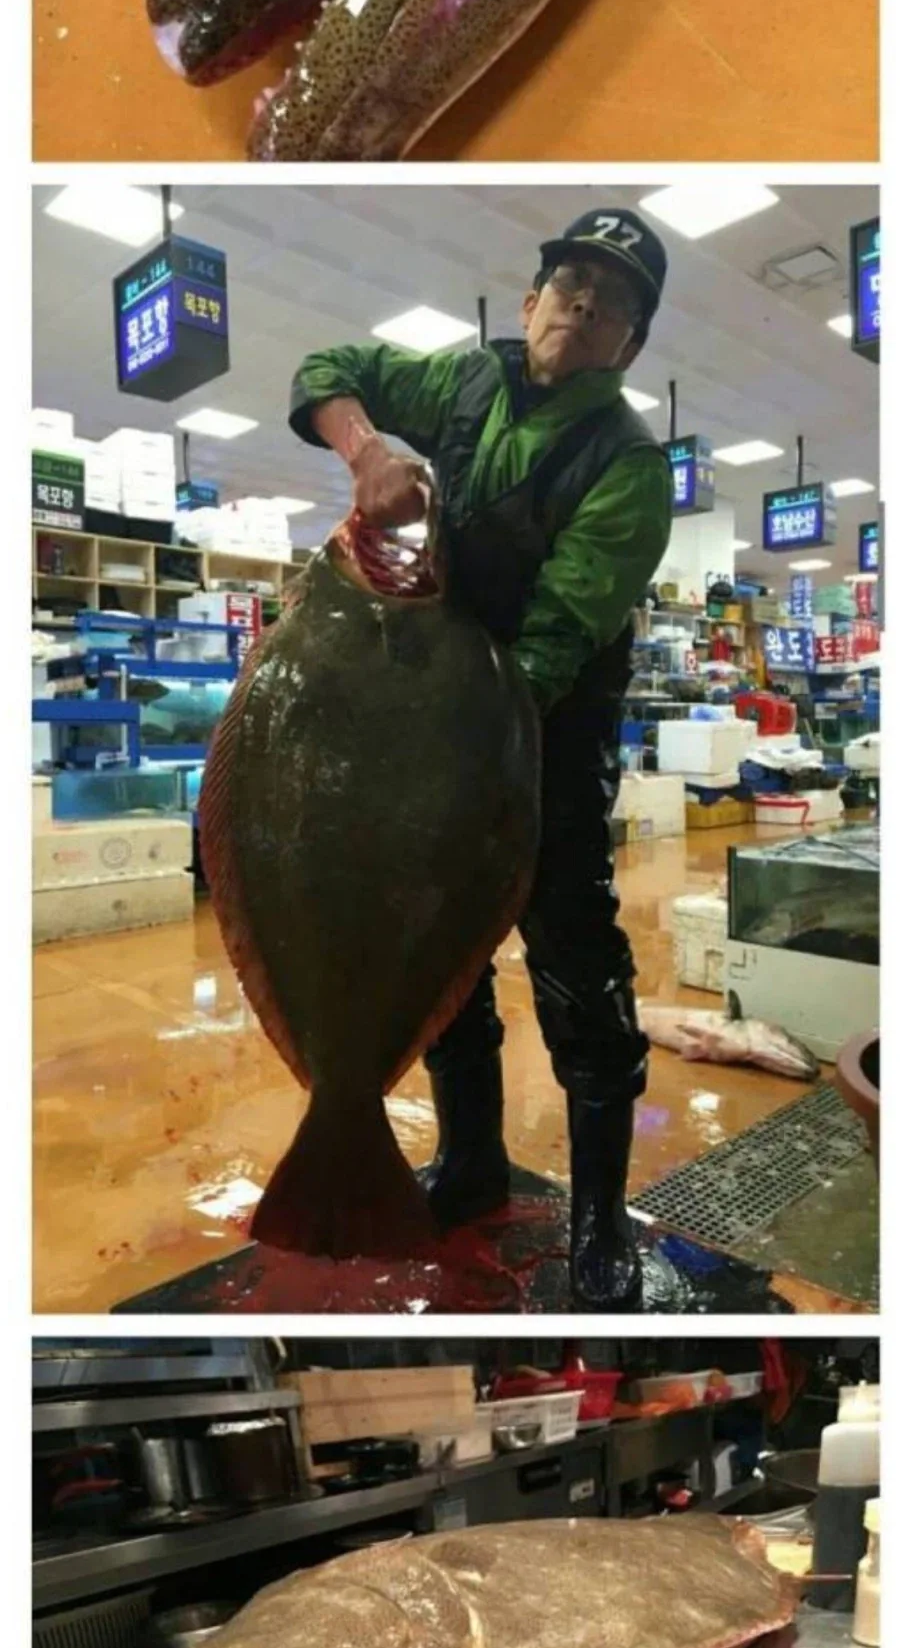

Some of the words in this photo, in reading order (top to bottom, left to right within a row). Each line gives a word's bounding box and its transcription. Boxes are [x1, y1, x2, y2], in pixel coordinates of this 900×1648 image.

[593, 215, 643, 251] 77
[126, 296, 170, 351] 목포항
[183, 290, 222, 324] 목포항
[36, 483, 75, 510] 목포항
